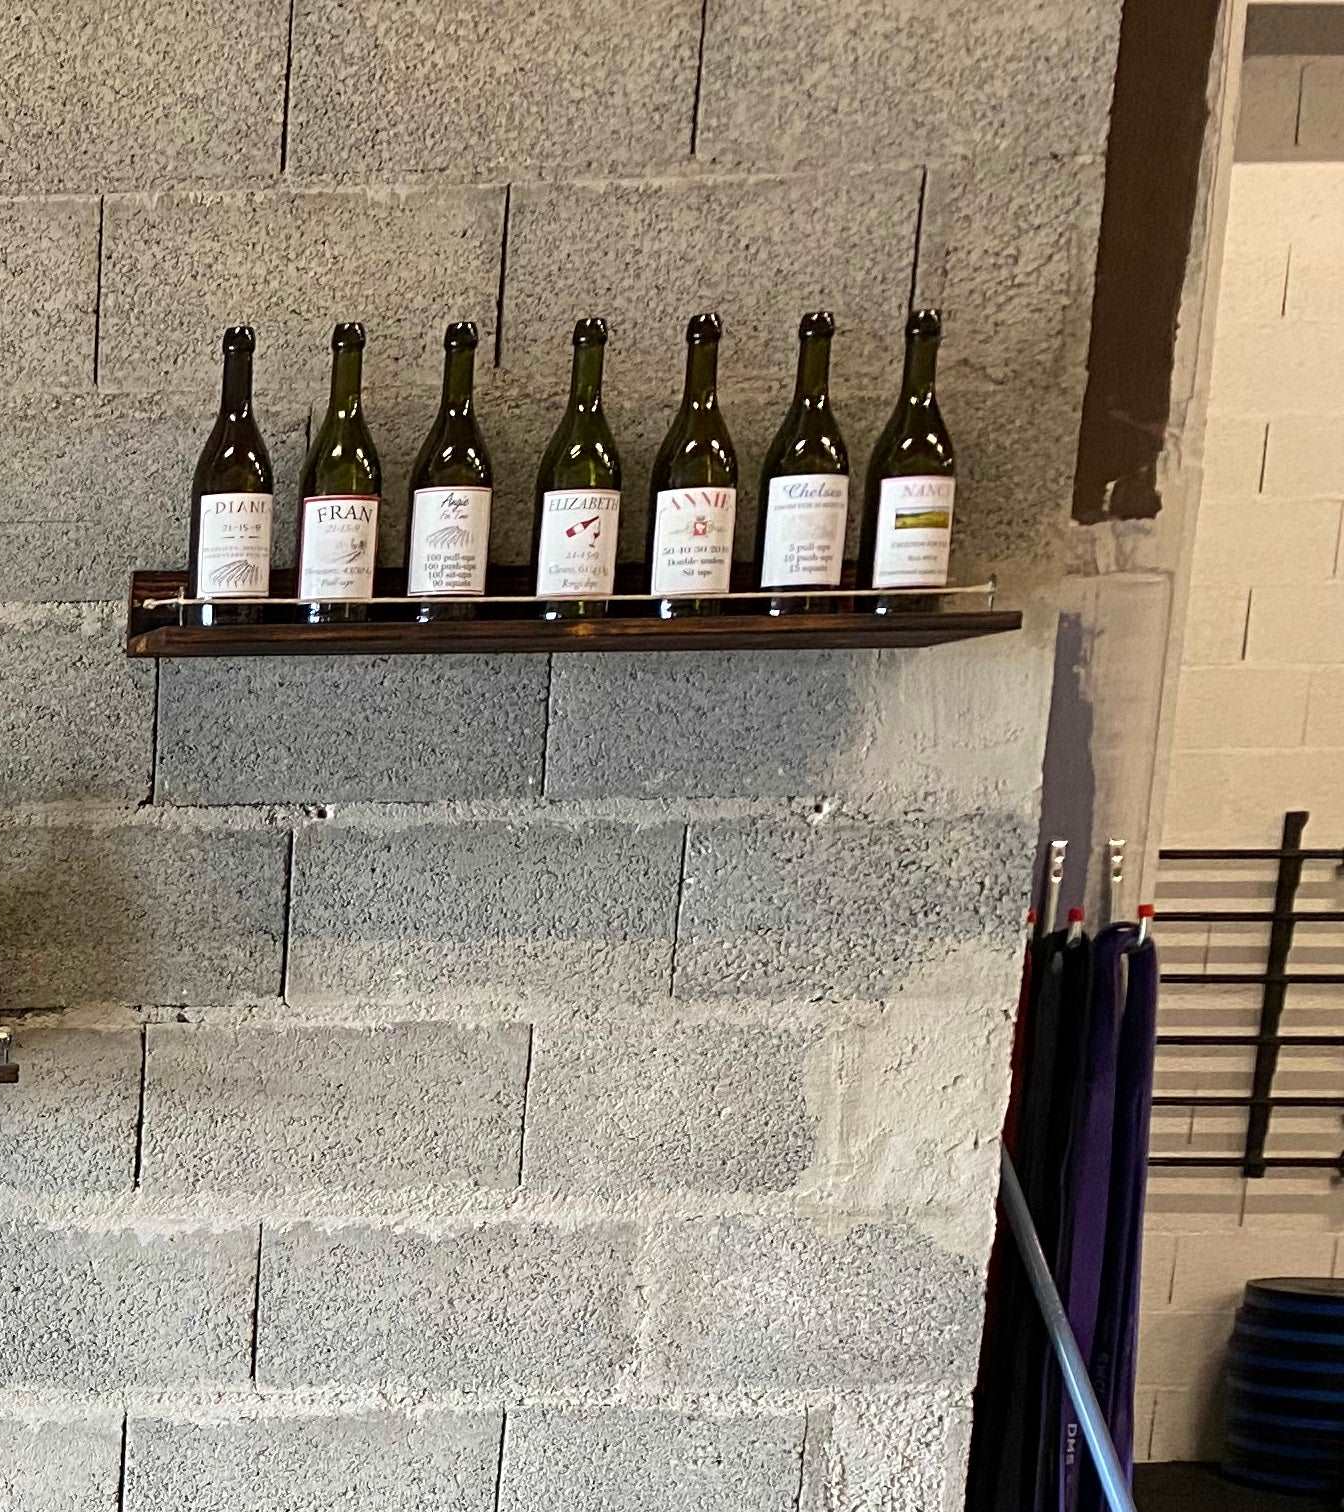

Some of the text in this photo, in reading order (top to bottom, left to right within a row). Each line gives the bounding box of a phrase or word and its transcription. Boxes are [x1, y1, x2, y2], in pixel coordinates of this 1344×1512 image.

[784, 482, 842, 498] Chelsea
[317, 505, 372, 523] FRAN
[426, 553, 475, 563] 100 pull-ups
[424, 563, 476, 572] 100 push-ups
[428, 571, 443, 579] 100
